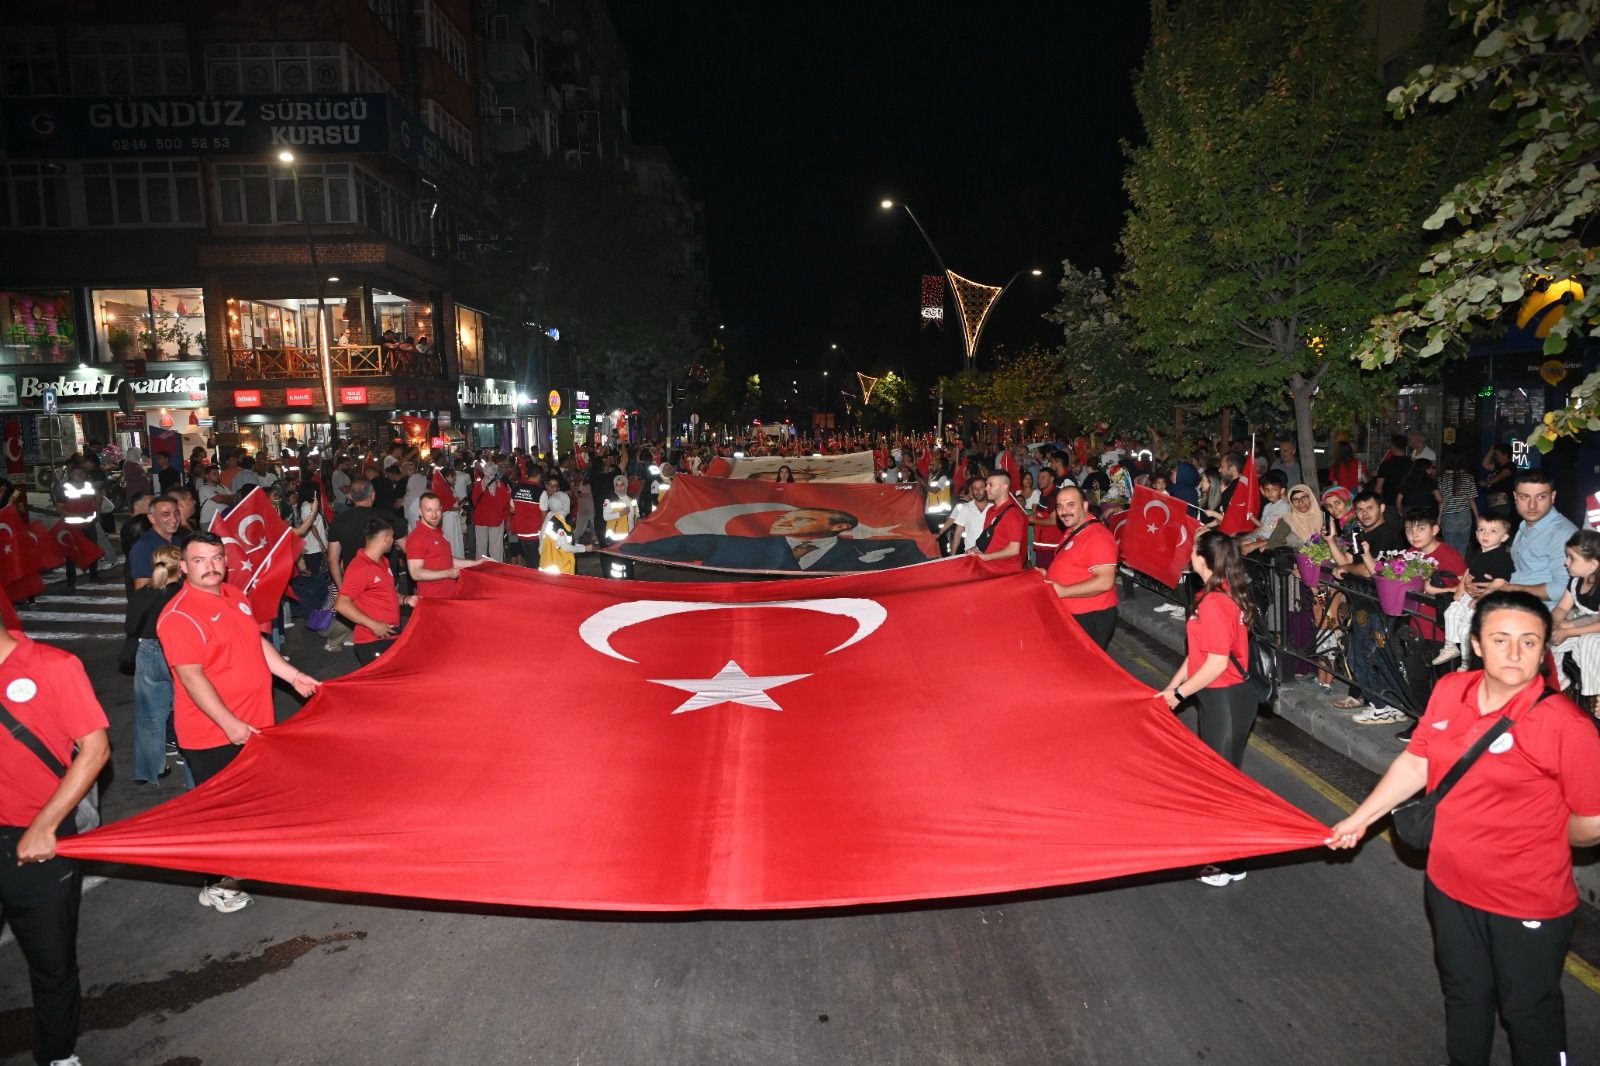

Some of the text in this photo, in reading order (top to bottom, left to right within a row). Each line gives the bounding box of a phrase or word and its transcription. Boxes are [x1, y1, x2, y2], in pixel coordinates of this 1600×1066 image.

[88, 95, 246, 129] GÜNDÜZ
[260, 96, 369, 122] SÜRÜCÜ
[156, 137, 183, 150] 500
[212, 136, 231, 149] 53
[270, 124, 361, 146] KURSU
[46, 391, 55, 412] P
